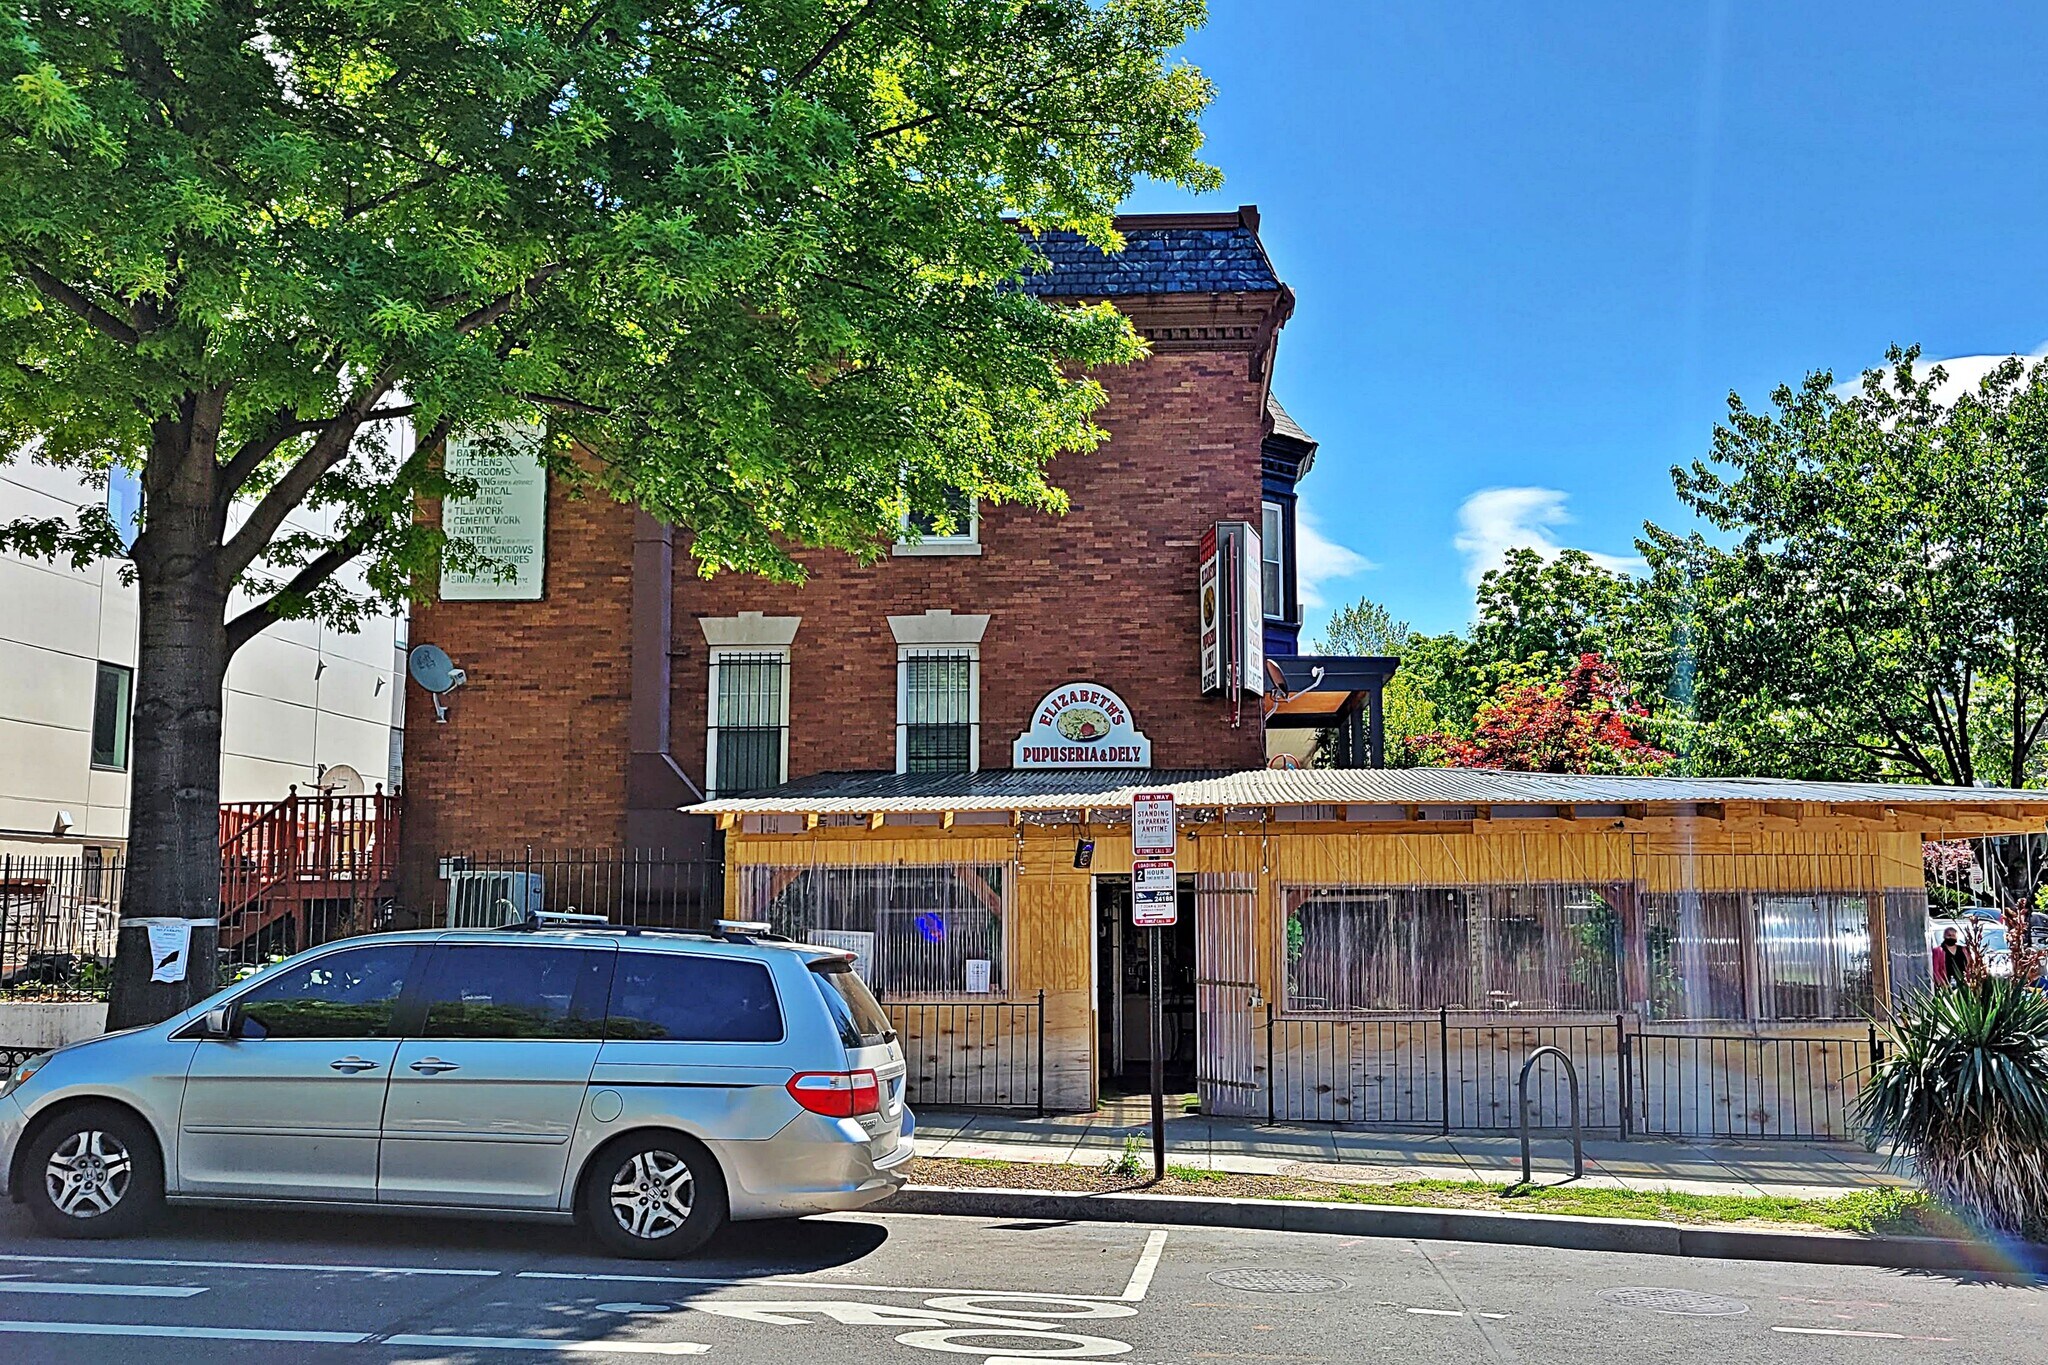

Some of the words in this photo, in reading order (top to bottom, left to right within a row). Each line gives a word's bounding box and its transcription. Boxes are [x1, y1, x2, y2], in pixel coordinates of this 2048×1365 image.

[456, 458, 503, 467] KITCHENS
[454, 506, 504, 515] TILEWORK
[453, 516, 490, 525] CEMENT
[494, 516, 520, 524] WORK
[453, 526, 496, 535] PAINTING
[490, 545, 534, 554] WINDOWS
[1039, 689, 1125, 727] ELIZABETH'S
[1146, 817, 1170, 825] PARKING
[1141, 825, 1168, 833] ANYTIME
[1137, 870, 1143, 881] 2
